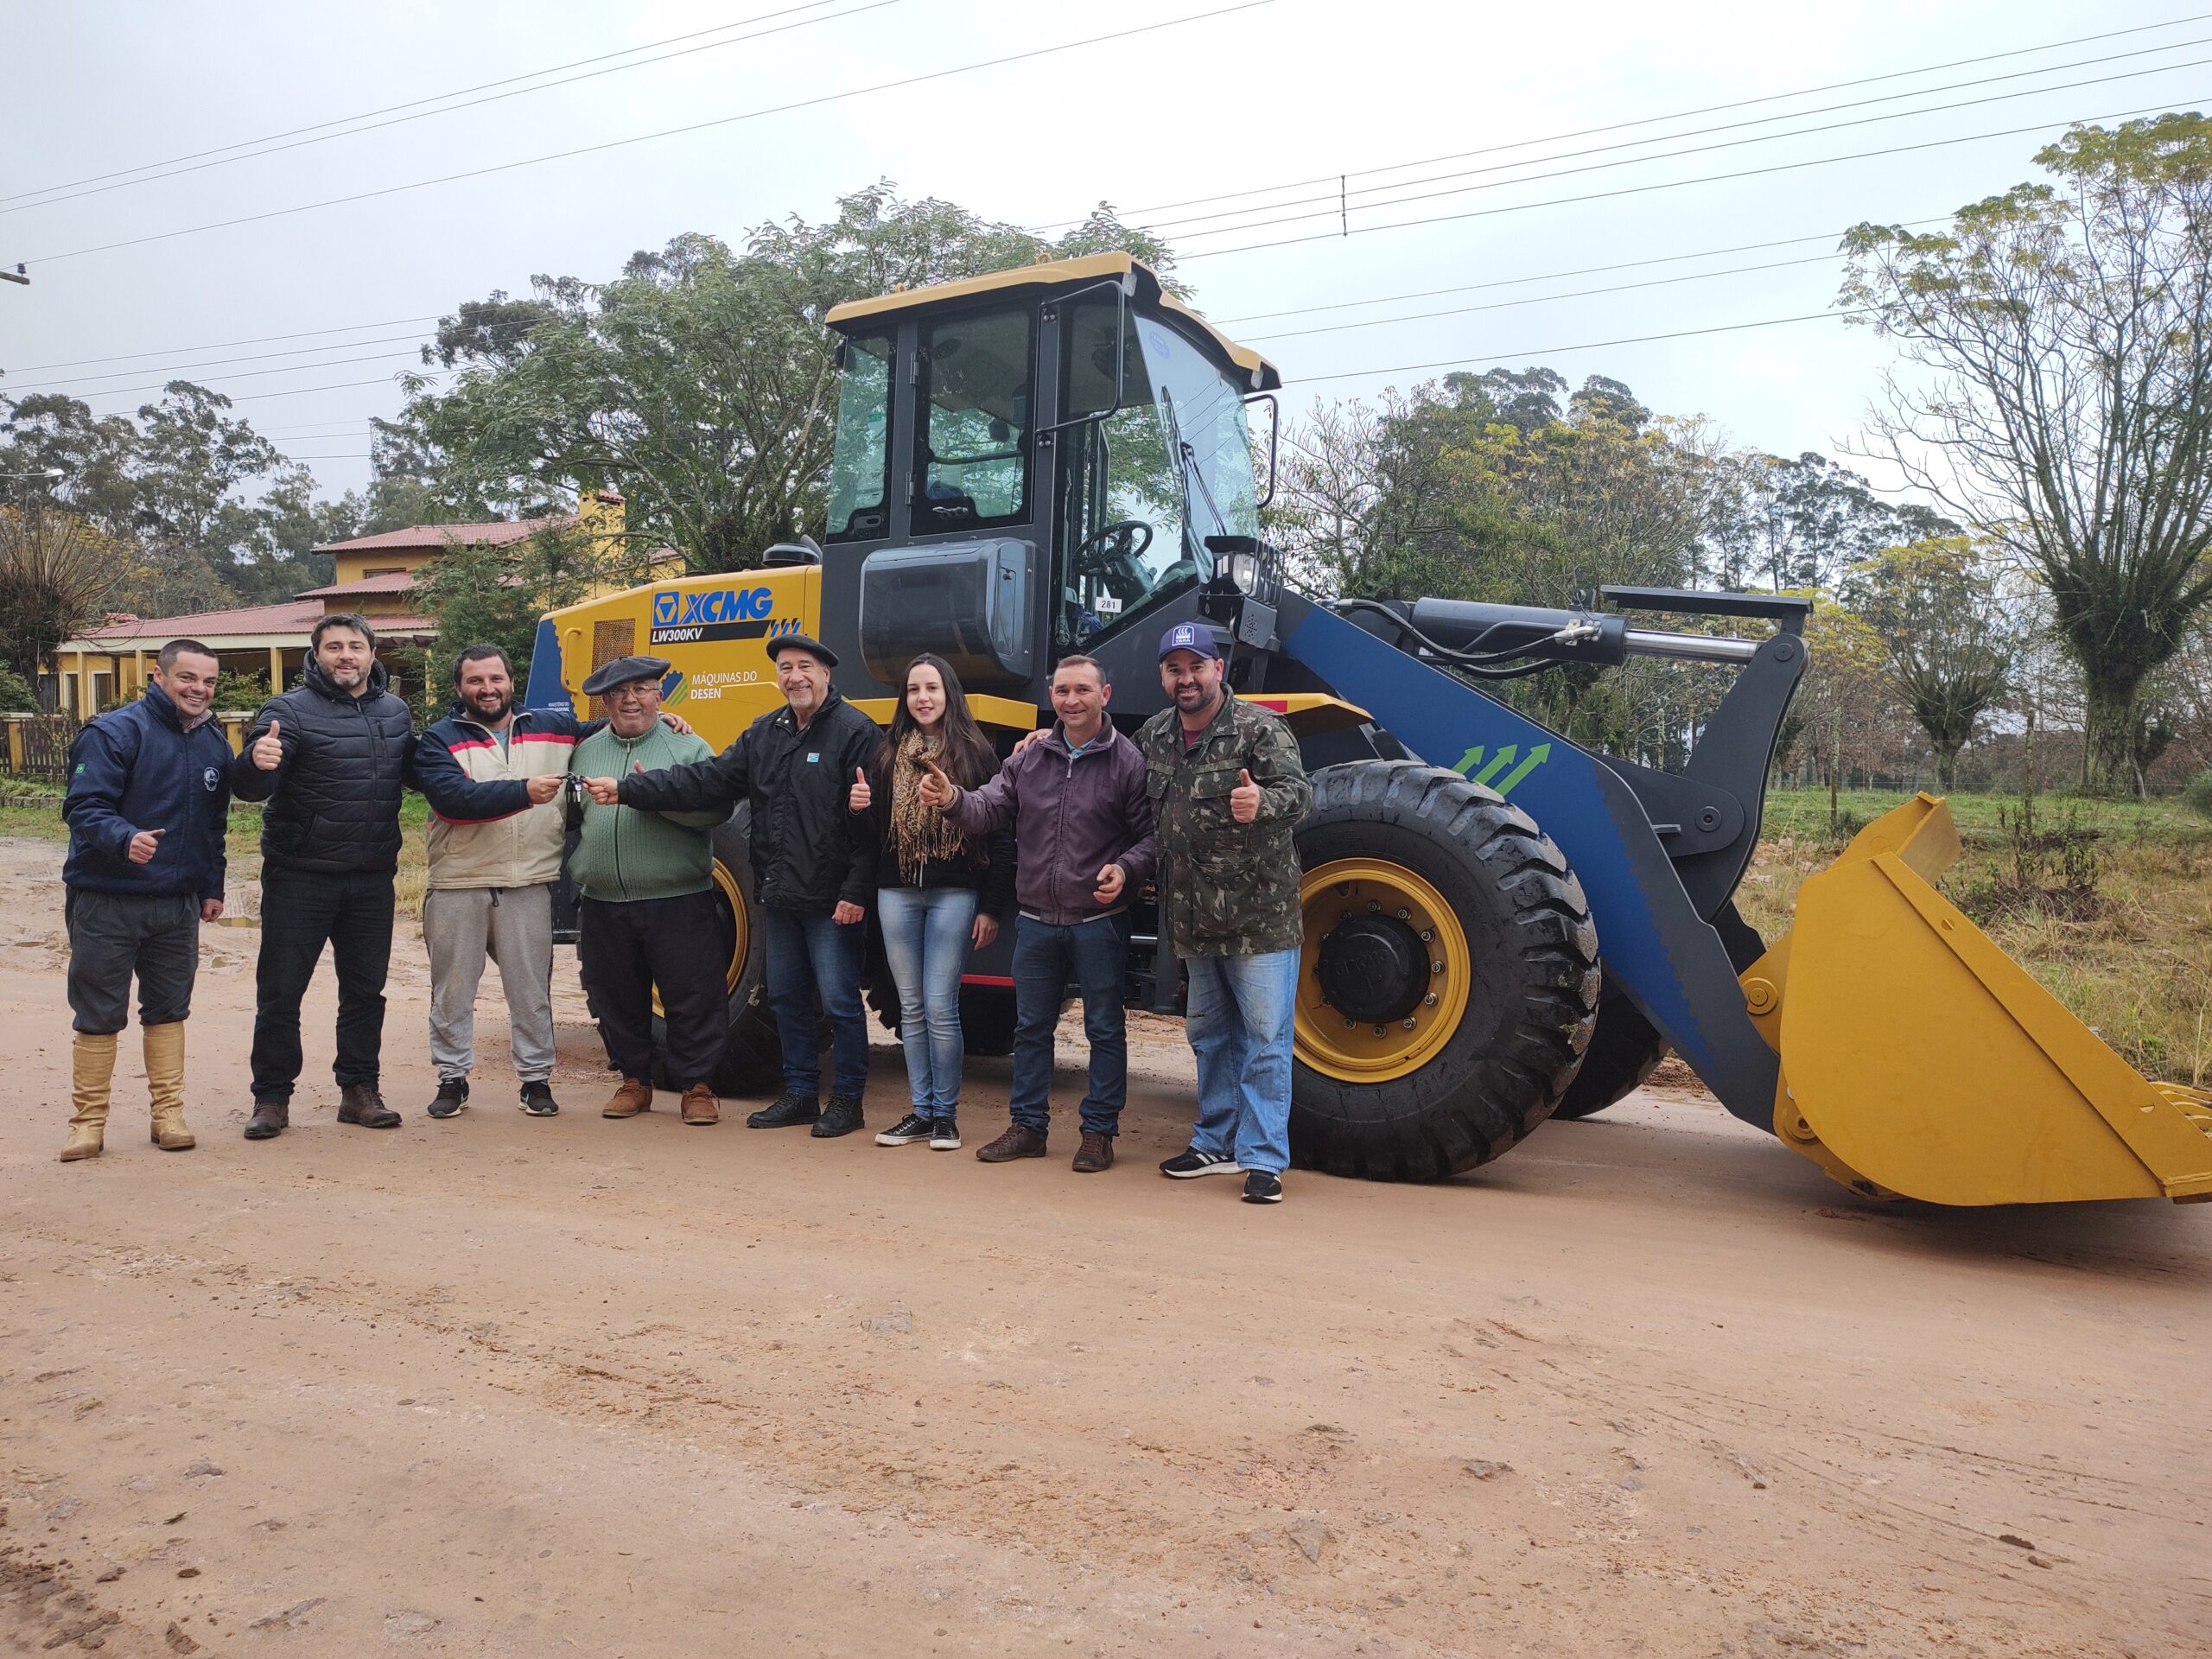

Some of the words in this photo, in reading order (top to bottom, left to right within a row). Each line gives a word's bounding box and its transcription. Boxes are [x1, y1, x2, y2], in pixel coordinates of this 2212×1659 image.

[678, 587, 773, 625] XCMG
[1101, 600, 1116, 609] 281
[652, 627, 703, 643] LW300KV
[692, 671, 741, 687] MÁQUINAS
[743, 671, 758, 682] DO
[690, 688, 721, 700] DESEN
